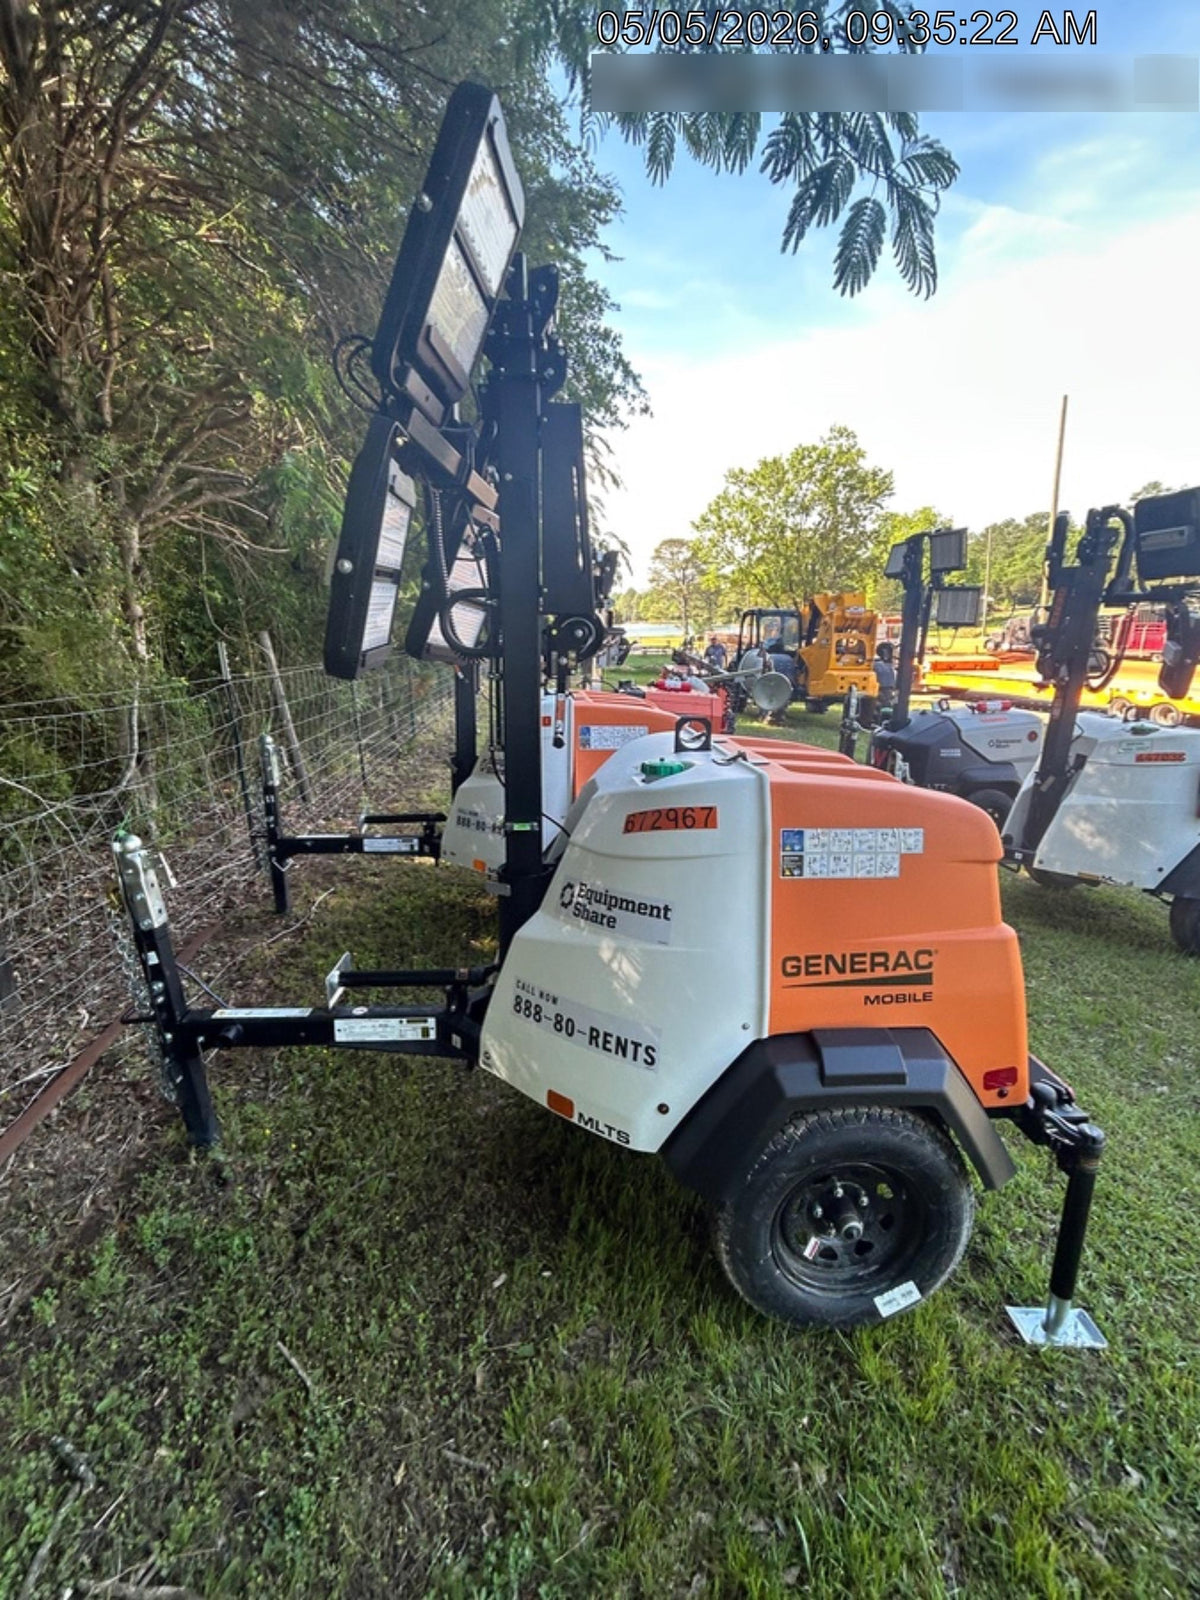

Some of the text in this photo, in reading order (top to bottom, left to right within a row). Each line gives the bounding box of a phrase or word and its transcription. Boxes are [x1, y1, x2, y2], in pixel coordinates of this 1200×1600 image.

[623, 806, 714, 833] 672967
[572, 901, 617, 929] Share
[578, 882, 672, 921] Equipment
[781, 949, 934, 977] GENERAC
[516, 979, 536, 996] CALL
[864, 991, 933, 1006] MOBILE
[513, 994, 657, 1067] 888-80-RENTS
[577, 1112, 630, 1145] MLTS
